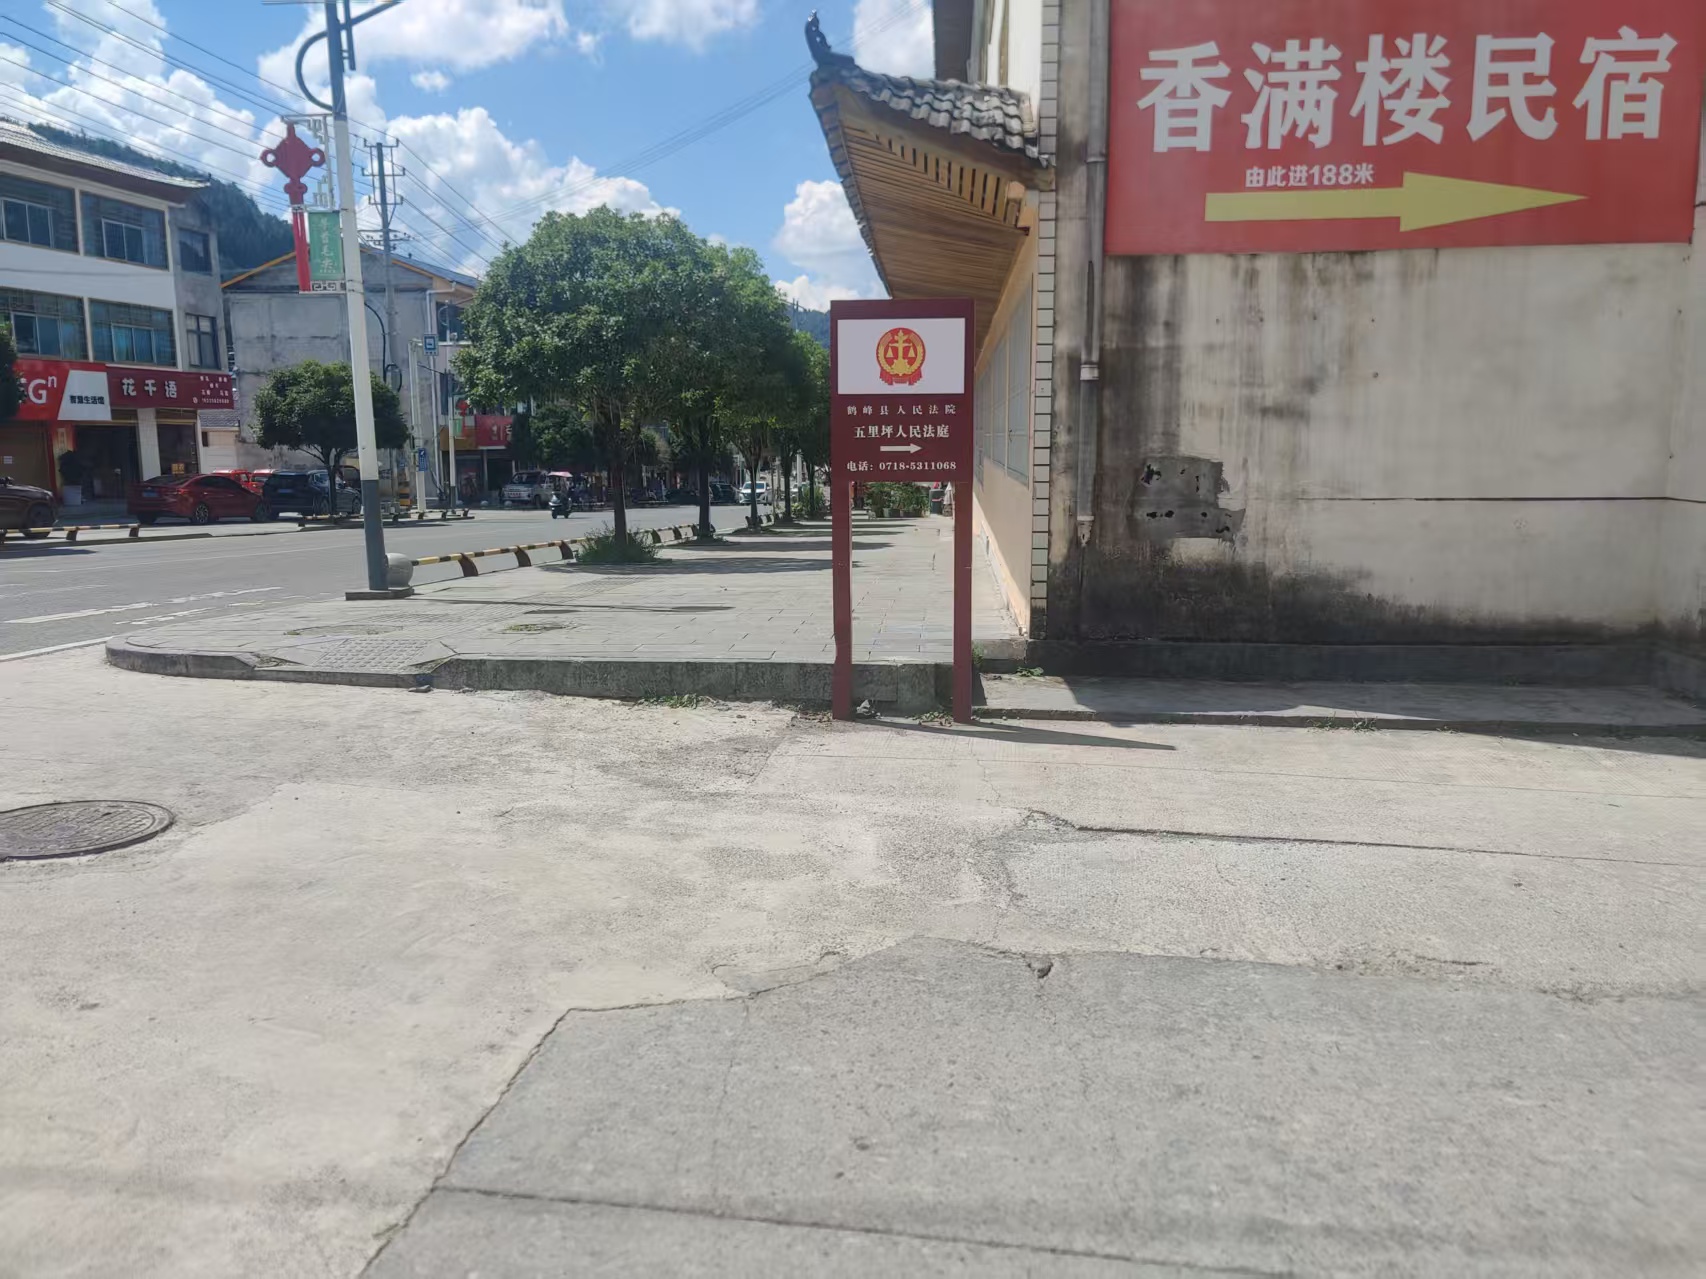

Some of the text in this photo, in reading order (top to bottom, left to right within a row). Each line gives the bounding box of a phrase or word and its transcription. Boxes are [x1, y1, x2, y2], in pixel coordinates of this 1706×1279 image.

[1137, 26, 1678, 153] 香满楼民宿
[1245, 162, 1375, 189] 由此进188米
[846, 404, 956, 416] 鹤峰县人民法院
[853, 424, 950, 439] 五里坪人民法庭
